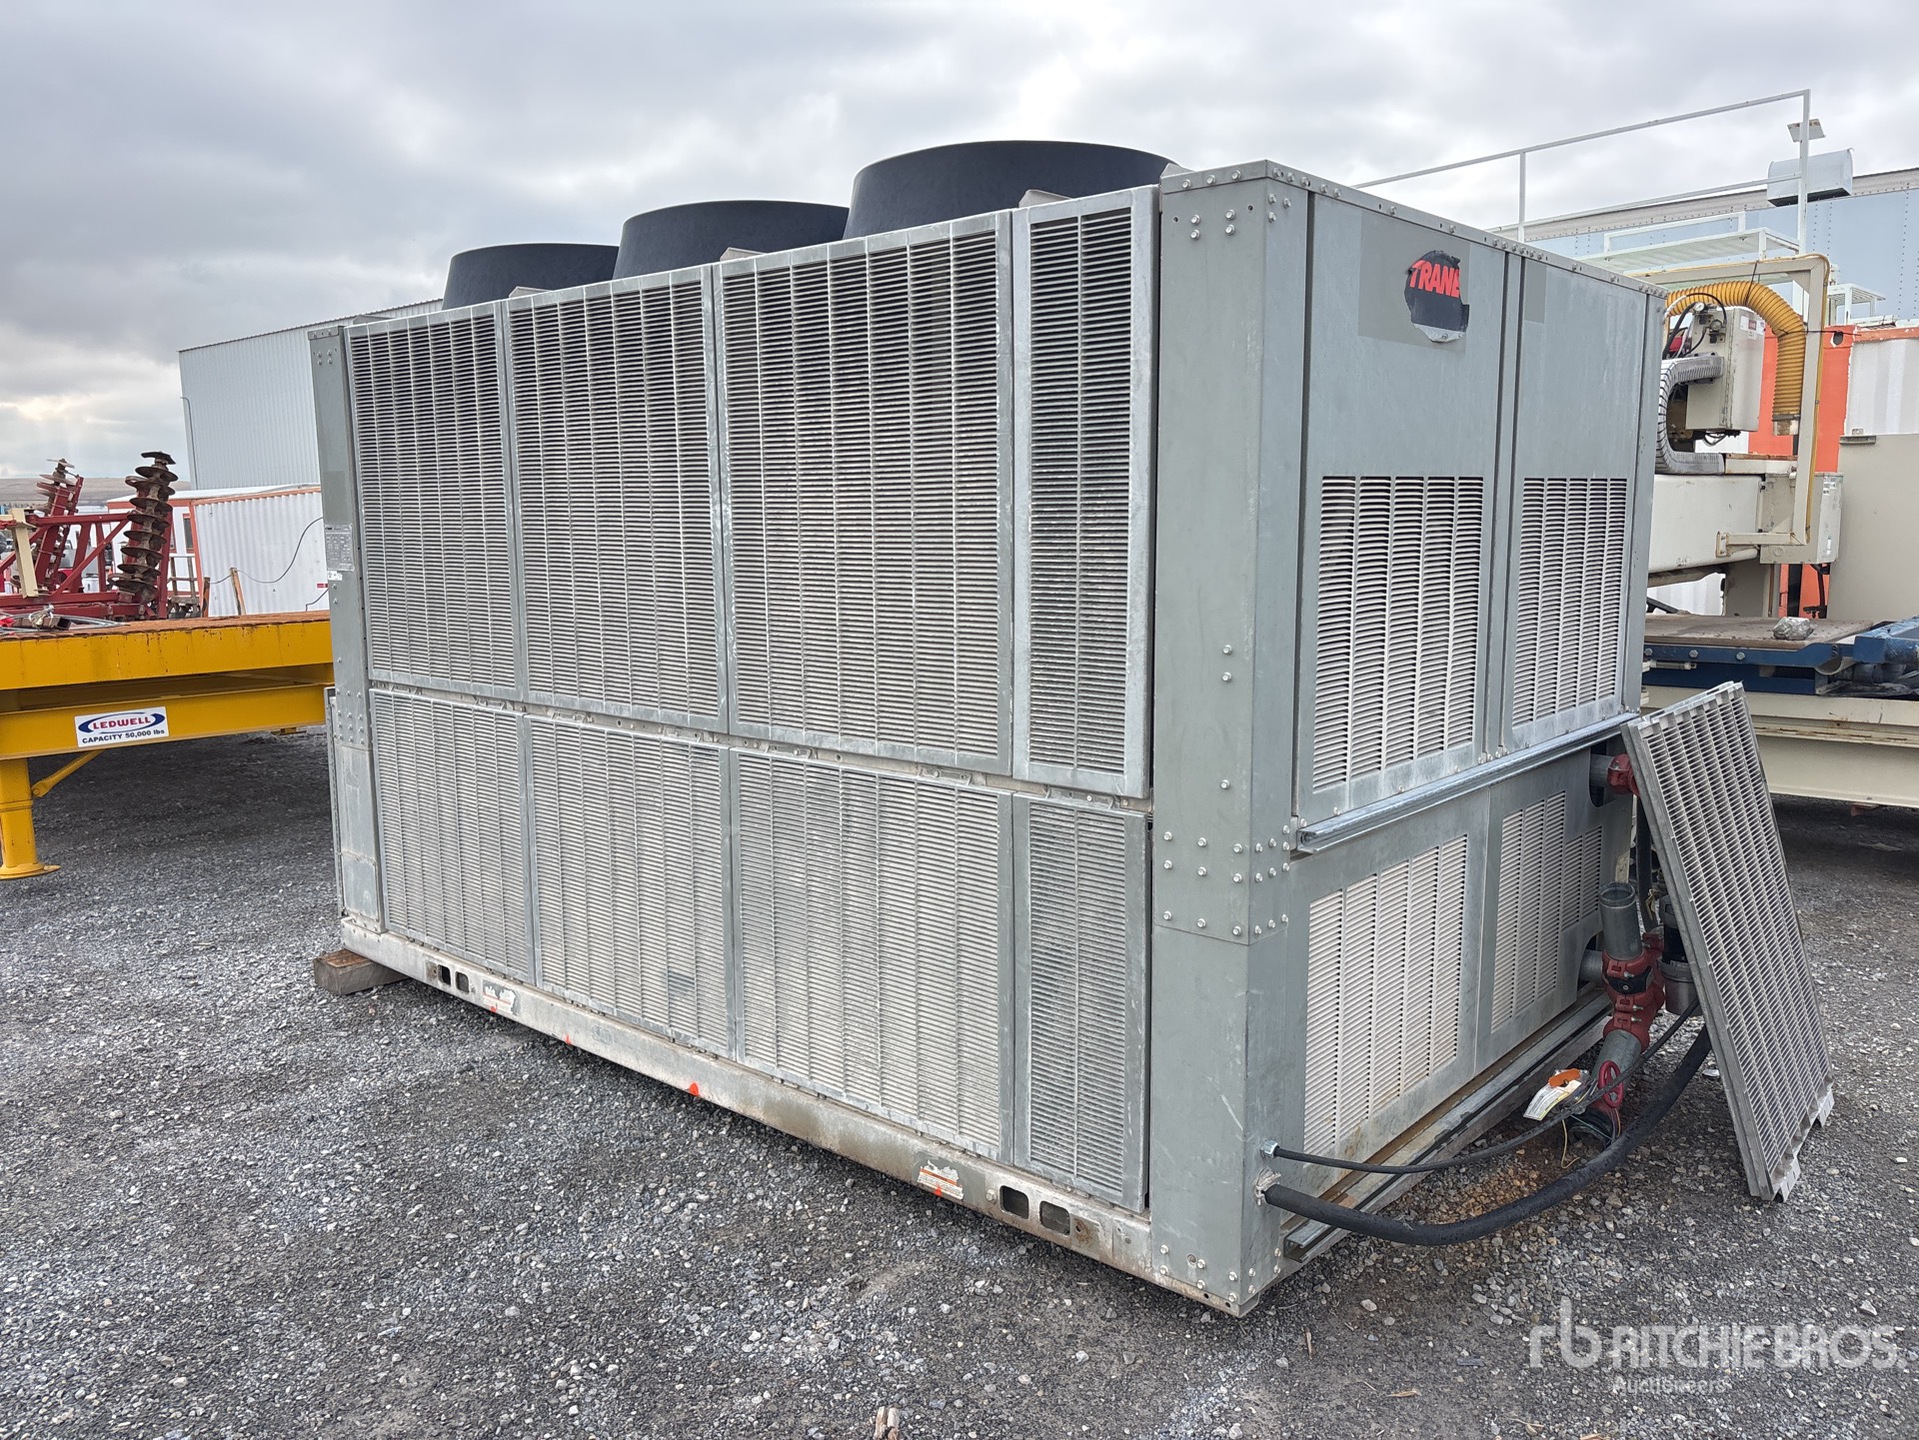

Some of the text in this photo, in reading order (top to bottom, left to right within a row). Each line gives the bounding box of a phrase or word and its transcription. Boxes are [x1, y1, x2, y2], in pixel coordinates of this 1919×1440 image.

[93, 717, 151, 730] LEDWELL
[82, 733, 123, 744] CAPACITY
[125, 730, 152, 739] 50,000
